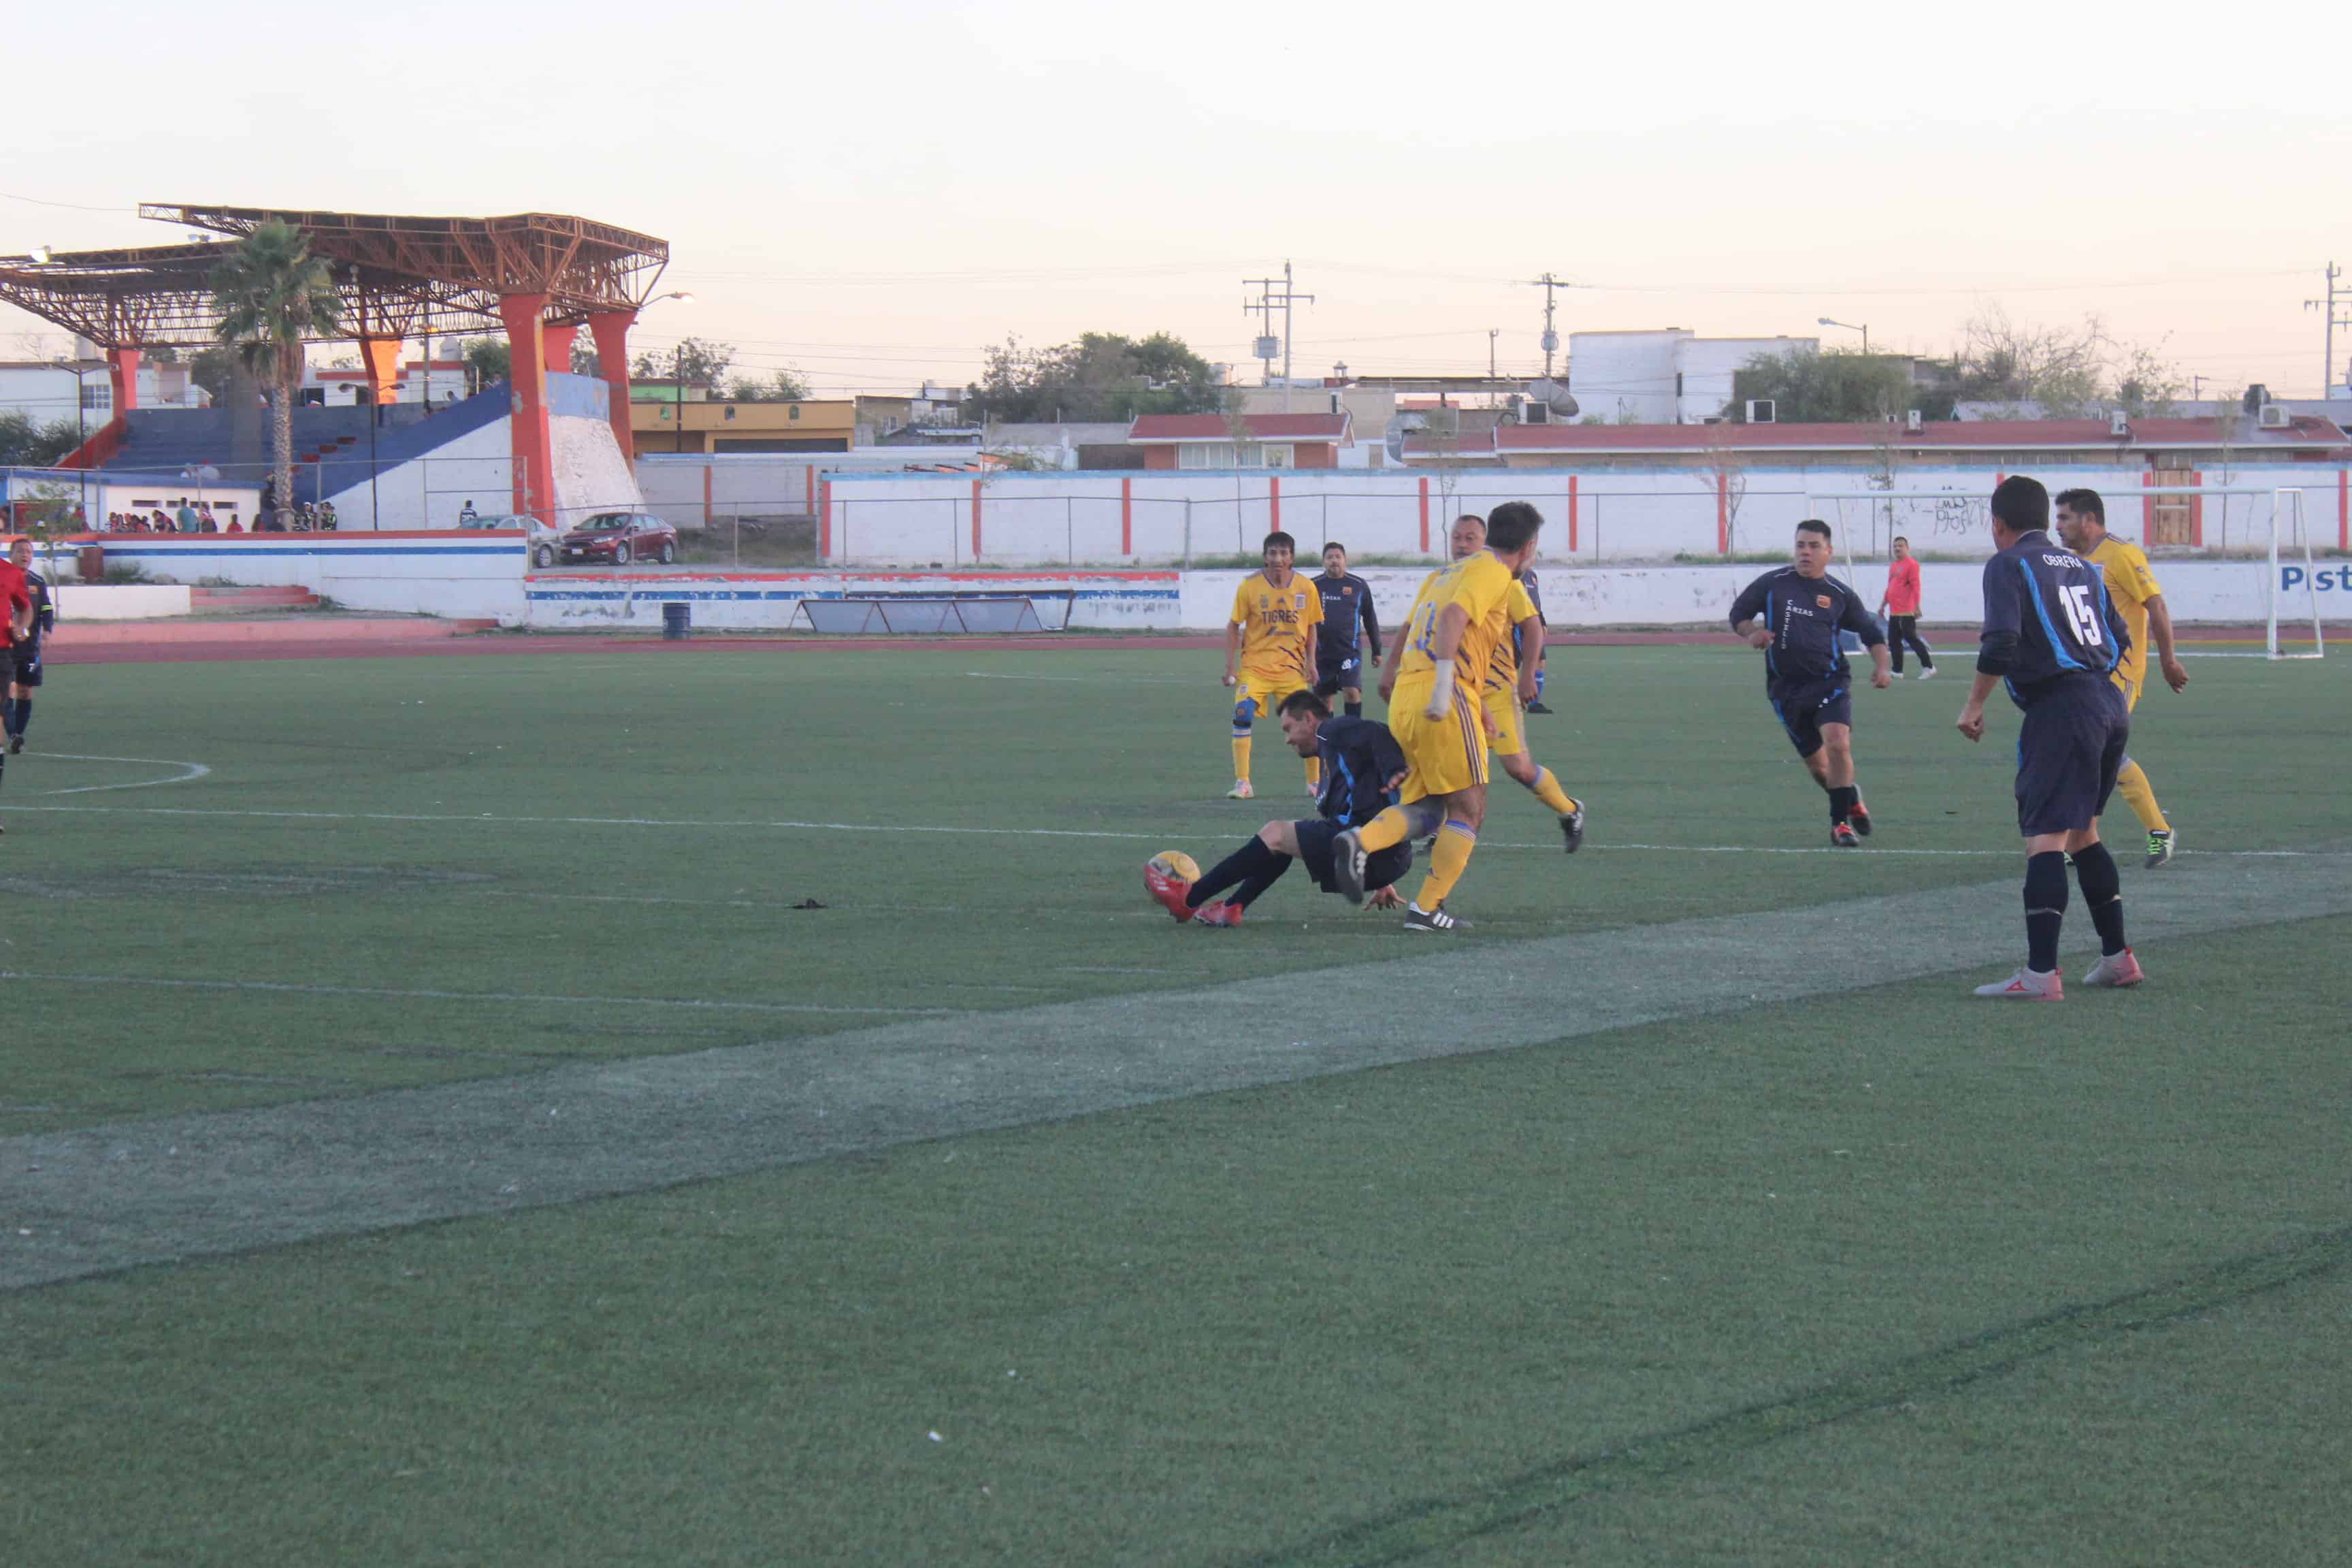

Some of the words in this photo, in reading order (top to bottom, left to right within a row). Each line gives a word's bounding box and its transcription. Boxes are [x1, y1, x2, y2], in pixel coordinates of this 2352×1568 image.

[2042, 554, 2085, 570] OBRERA
[1261, 610, 1299, 624] TIGRES
[2059, 585, 2102, 646] 15
